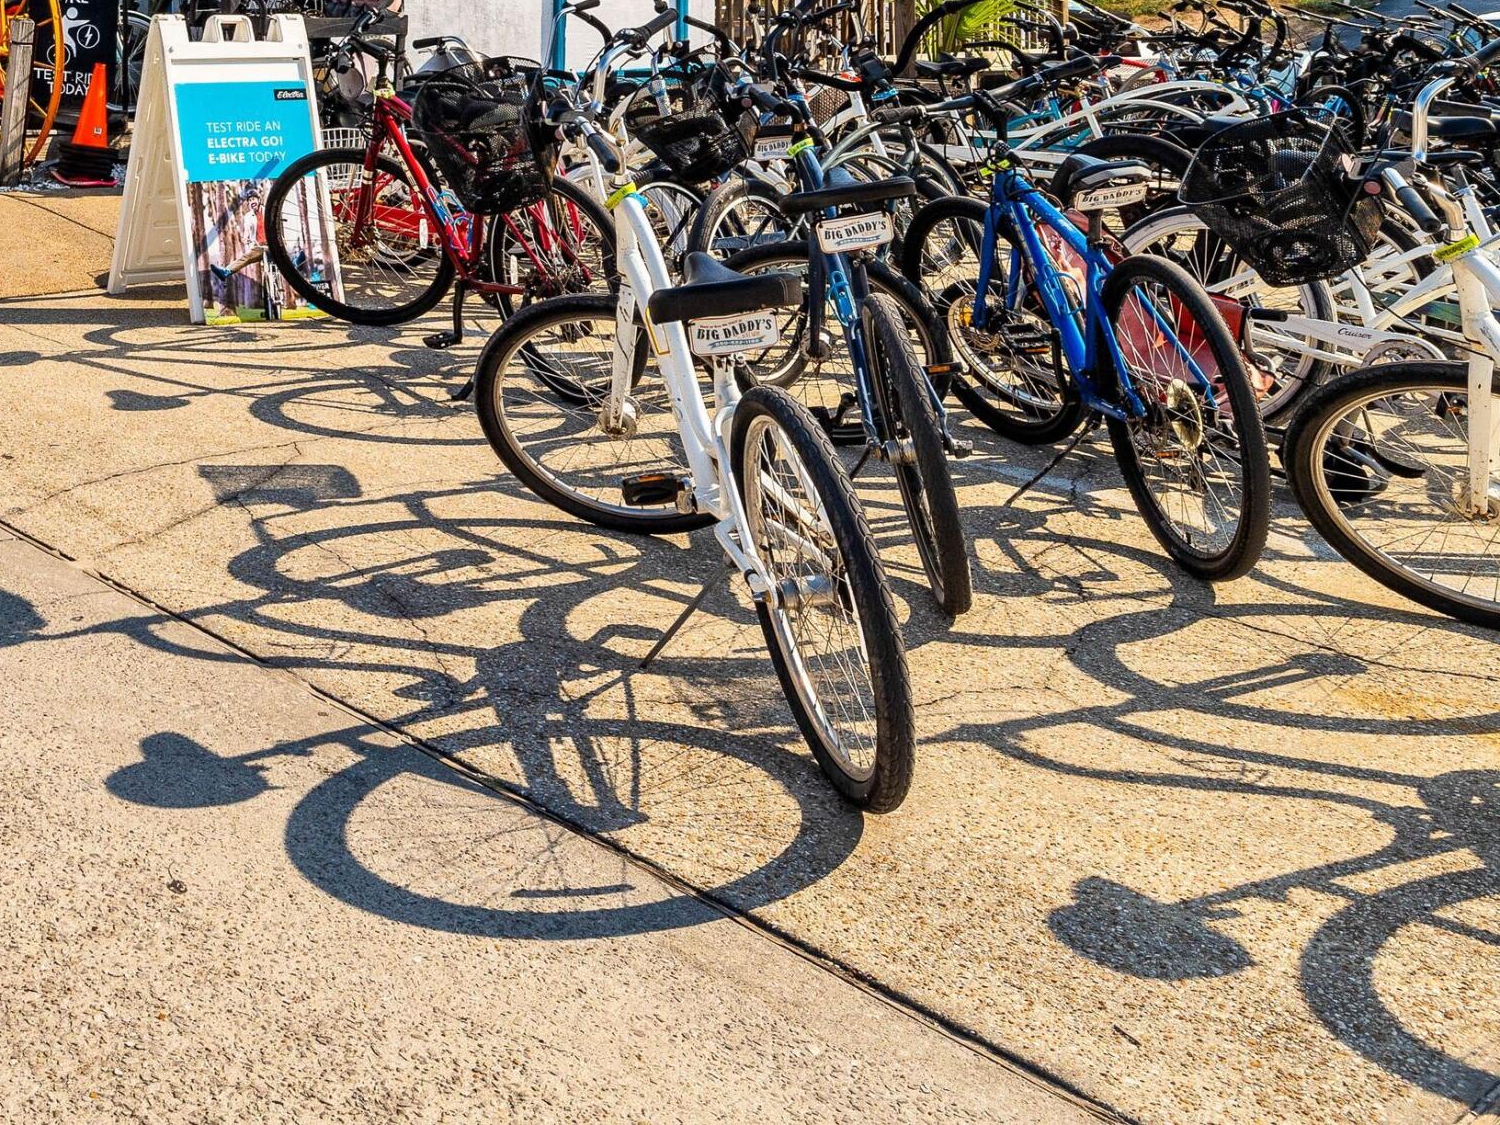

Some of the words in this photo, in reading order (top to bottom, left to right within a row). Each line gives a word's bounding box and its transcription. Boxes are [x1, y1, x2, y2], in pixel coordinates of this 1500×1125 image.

[33, 67, 72, 82] TET
[206, 122, 232, 133] TEST
[236, 121, 261, 132] RIDE
[265, 120, 281, 131] AN
[207, 137, 258, 148] ELECTRA
[209, 152, 245, 164] E-BIKE
[248, 151, 286, 163] TODAY
[1082, 195, 1099, 203] BIG
[824, 230, 843, 240] BIG
[845, 220, 887, 237] DADDY'S
[697, 328, 720, 341] BIG
[723, 318, 772, 339] DADDY'S
